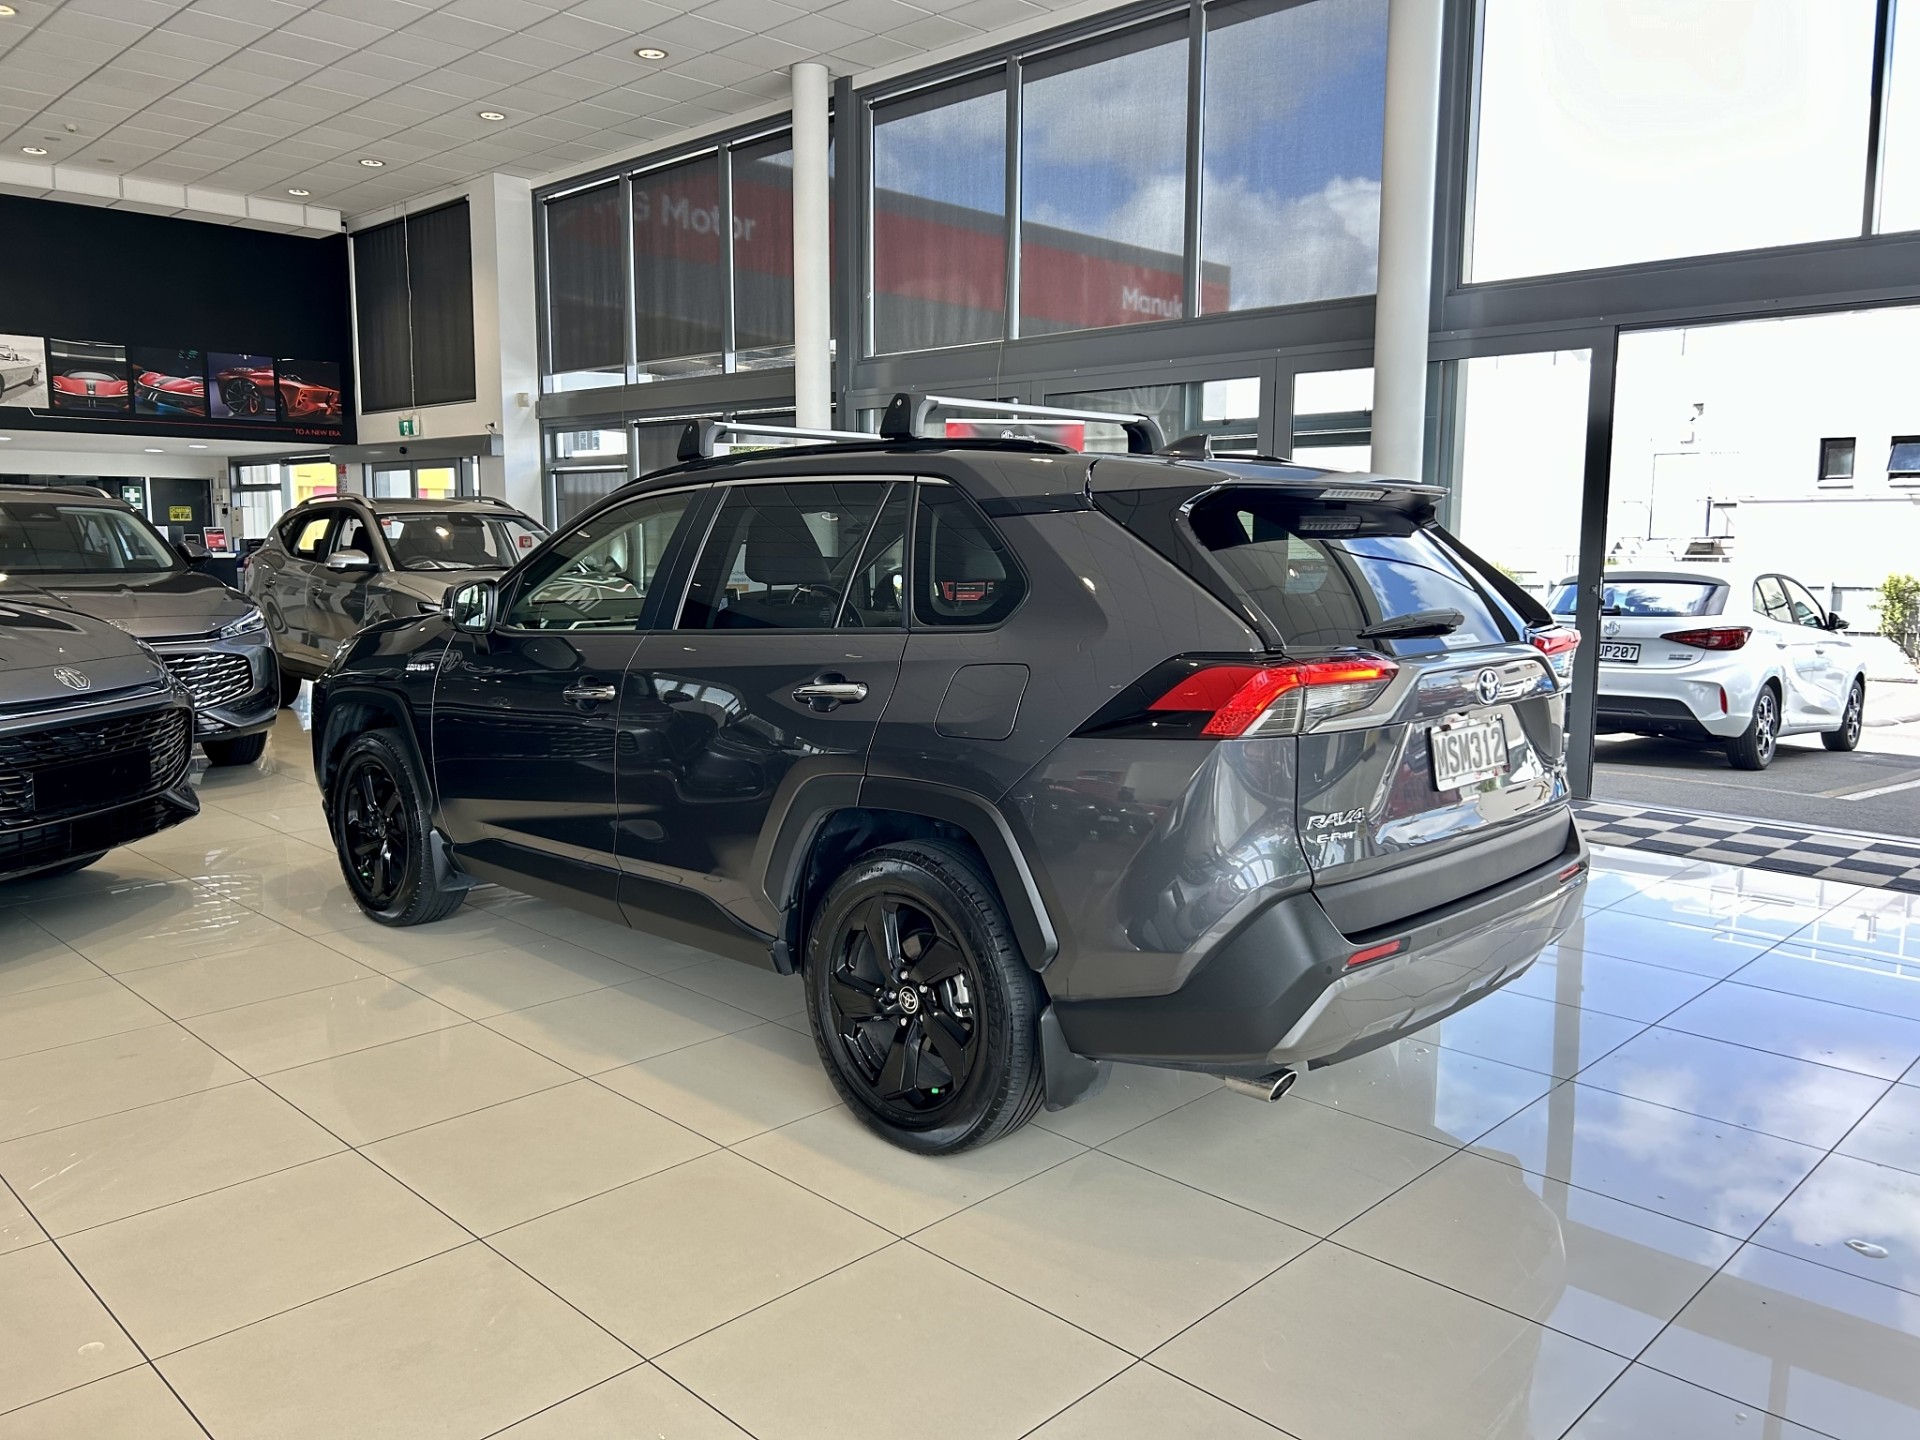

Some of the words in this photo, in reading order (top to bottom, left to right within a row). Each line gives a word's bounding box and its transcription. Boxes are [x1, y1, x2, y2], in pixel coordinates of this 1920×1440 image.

[1122, 285, 1205, 320] Manuk
[1434, 727, 1506, 777] MSM312
[1306, 807, 1365, 830] RAV4
